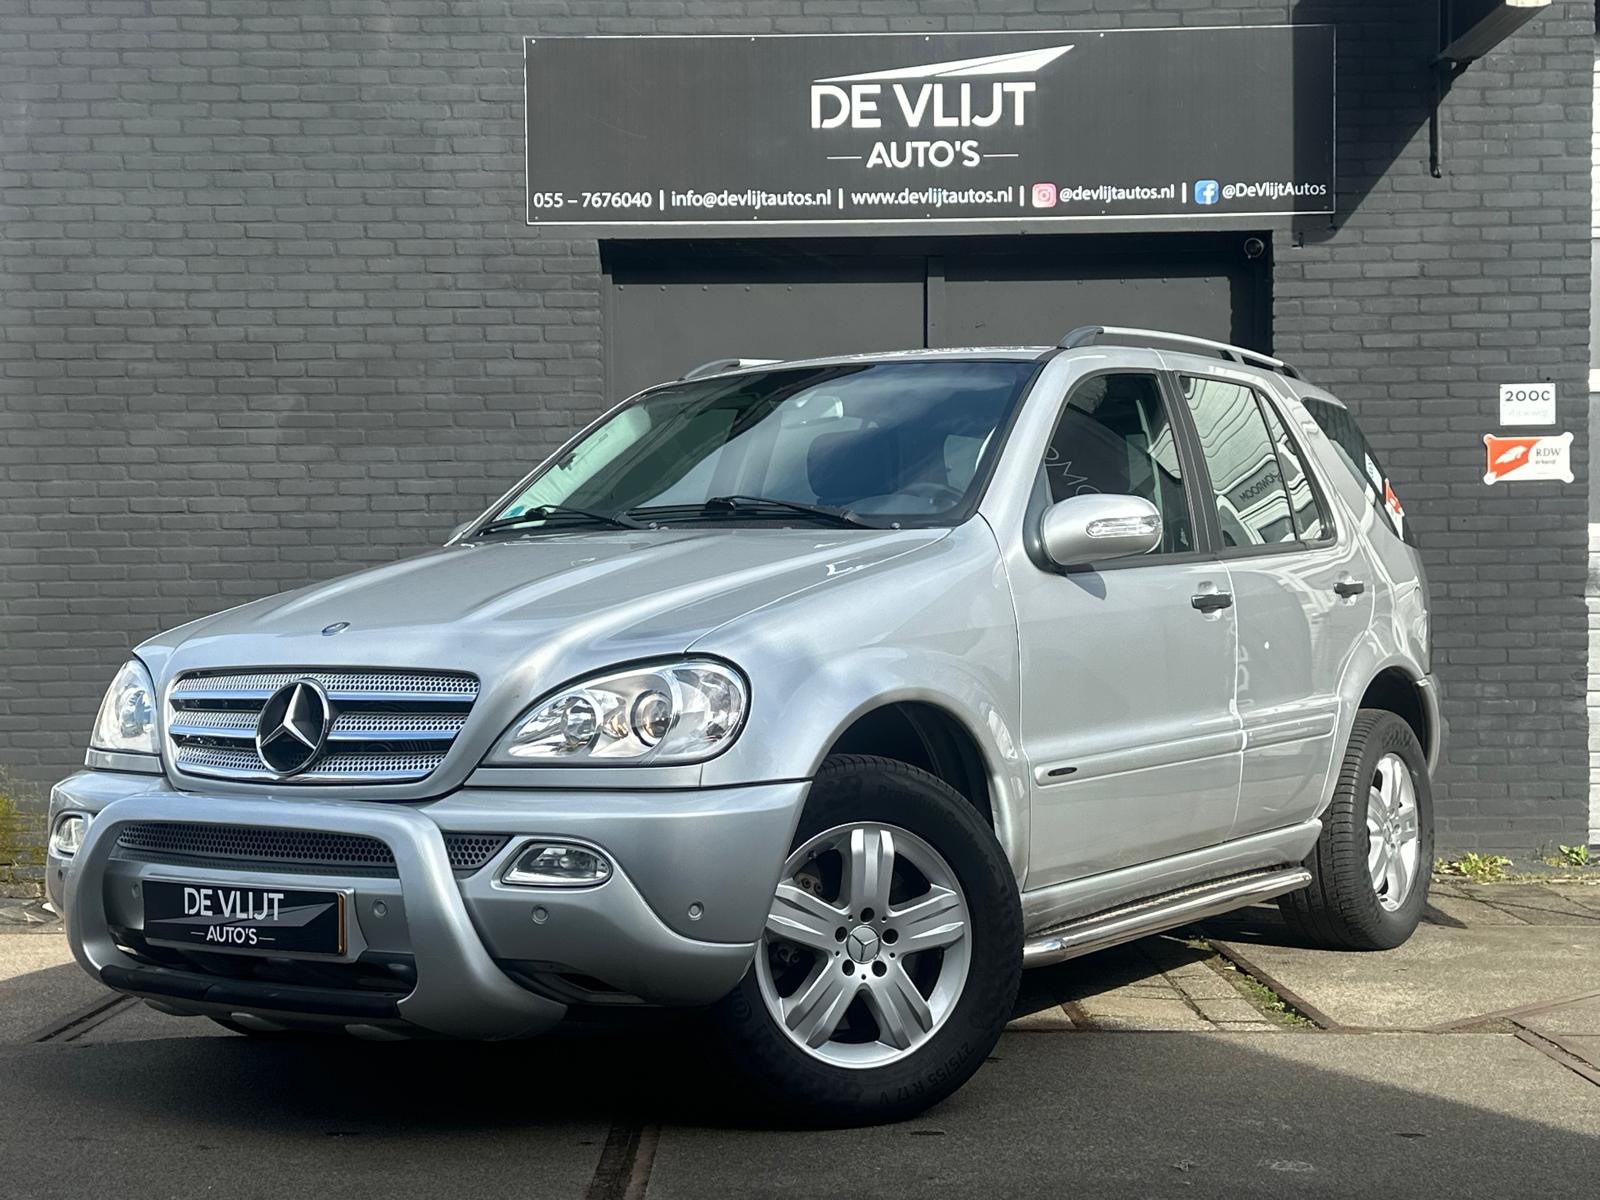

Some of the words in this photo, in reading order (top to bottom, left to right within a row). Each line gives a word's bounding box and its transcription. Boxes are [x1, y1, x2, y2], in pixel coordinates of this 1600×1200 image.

[810, 84, 882, 129] DE
[892, 81, 1037, 128] VLIJT
[865, 139, 981, 168] AUTO'S
[533, 192, 564, 208] 055
[581, 191, 652, 208] 7676040
[671, 188, 832, 210] info@devlijtautos.nl
[850, 186, 1013, 208] www.devlijtautos.nl
[1059, 183, 1175, 204] @devlijtautos.nl
[1221, 181, 1327, 200] @DeVlijtAutos
[1536, 447, 1562, 457] RDW
[183, 887, 214, 917] DE
[217, 889, 285, 921] VLIJT
[206, 925, 258, 945] AUTO'S
